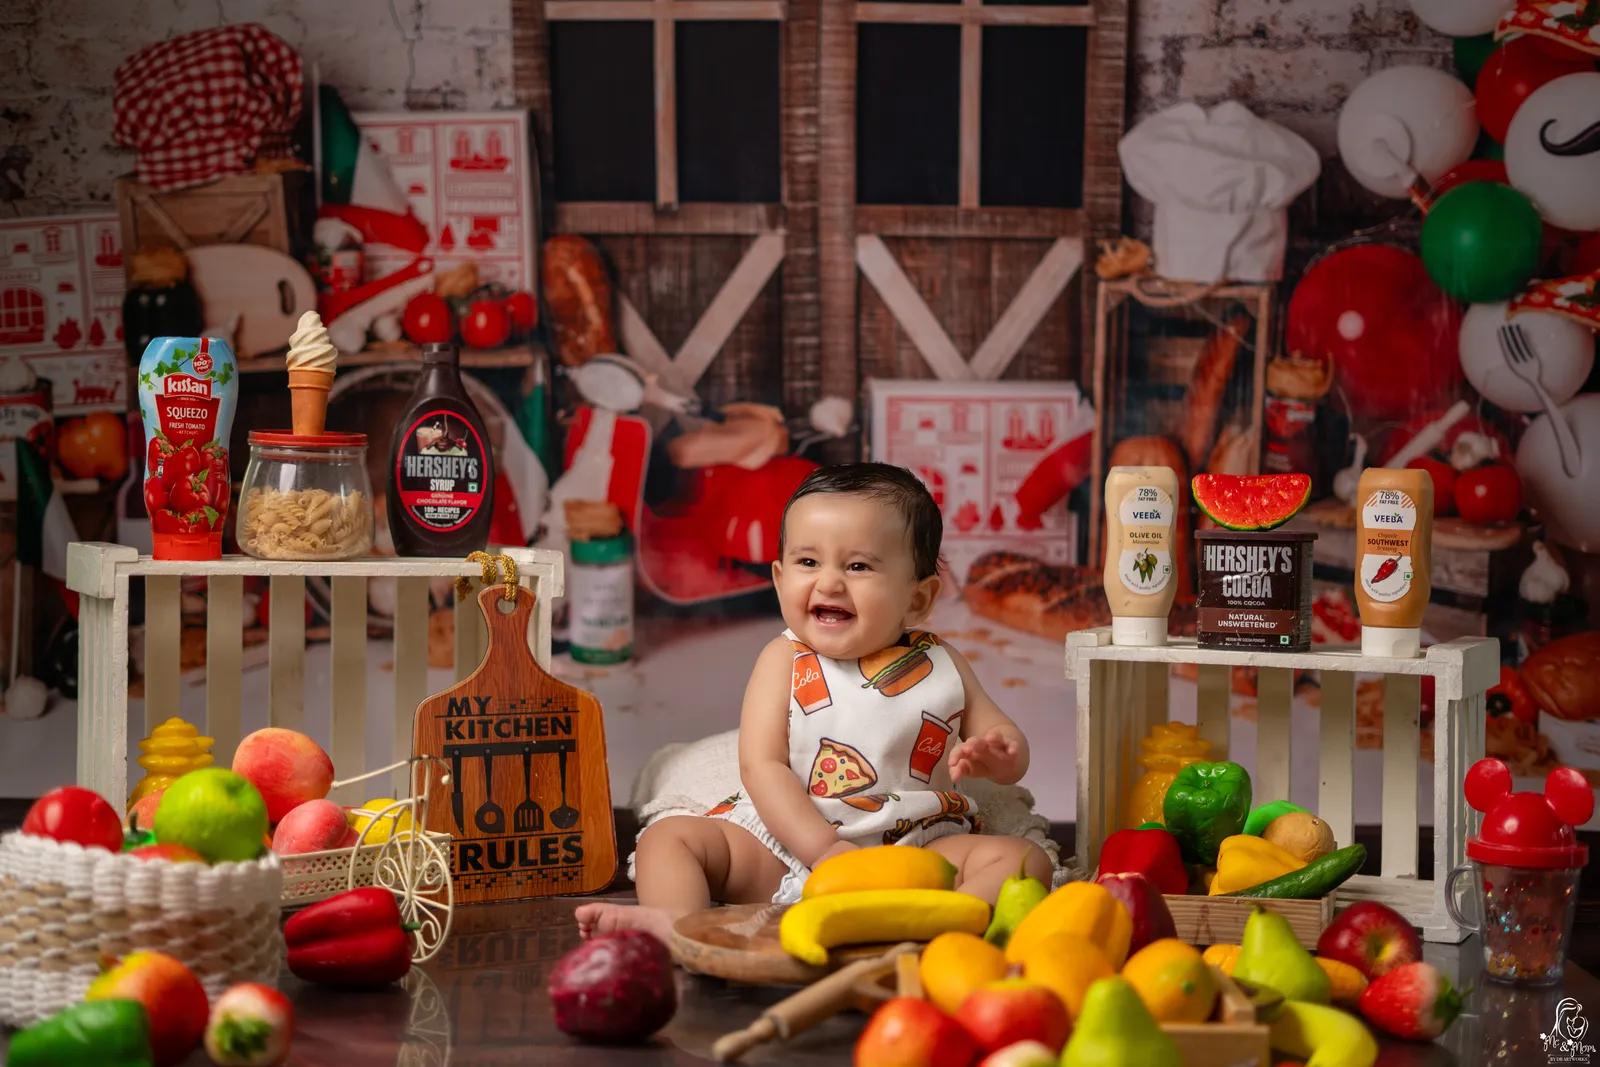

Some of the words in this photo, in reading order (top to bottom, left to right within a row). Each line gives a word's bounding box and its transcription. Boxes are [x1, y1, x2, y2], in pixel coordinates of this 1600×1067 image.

[166, 406, 208, 420] SQUEEZO
[406, 456, 478, 480] HERSHEY'S
[430, 478, 455, 491] SYRUP
[1138, 488, 1158, 497] 78%
[1380, 491, 1400, 500] 78%
[437, 506, 461, 514] RECIPES
[1133, 511, 1161, 520] VEEBA
[1374, 514, 1404, 524] VEEBA
[1367, 538, 1409, 547] SOUTHWEST
[1206, 546, 1292, 573] HERSHEY'S
[1222, 575, 1273, 598] COCOA
[1228, 613, 1265, 621] NATURAL
[792, 668, 820, 690] Cola
[446, 696, 492, 718] MY
[445, 715, 572, 741] KITCHEN
[918, 738, 942, 756] Cola
[459, 835, 585, 872] RULES
